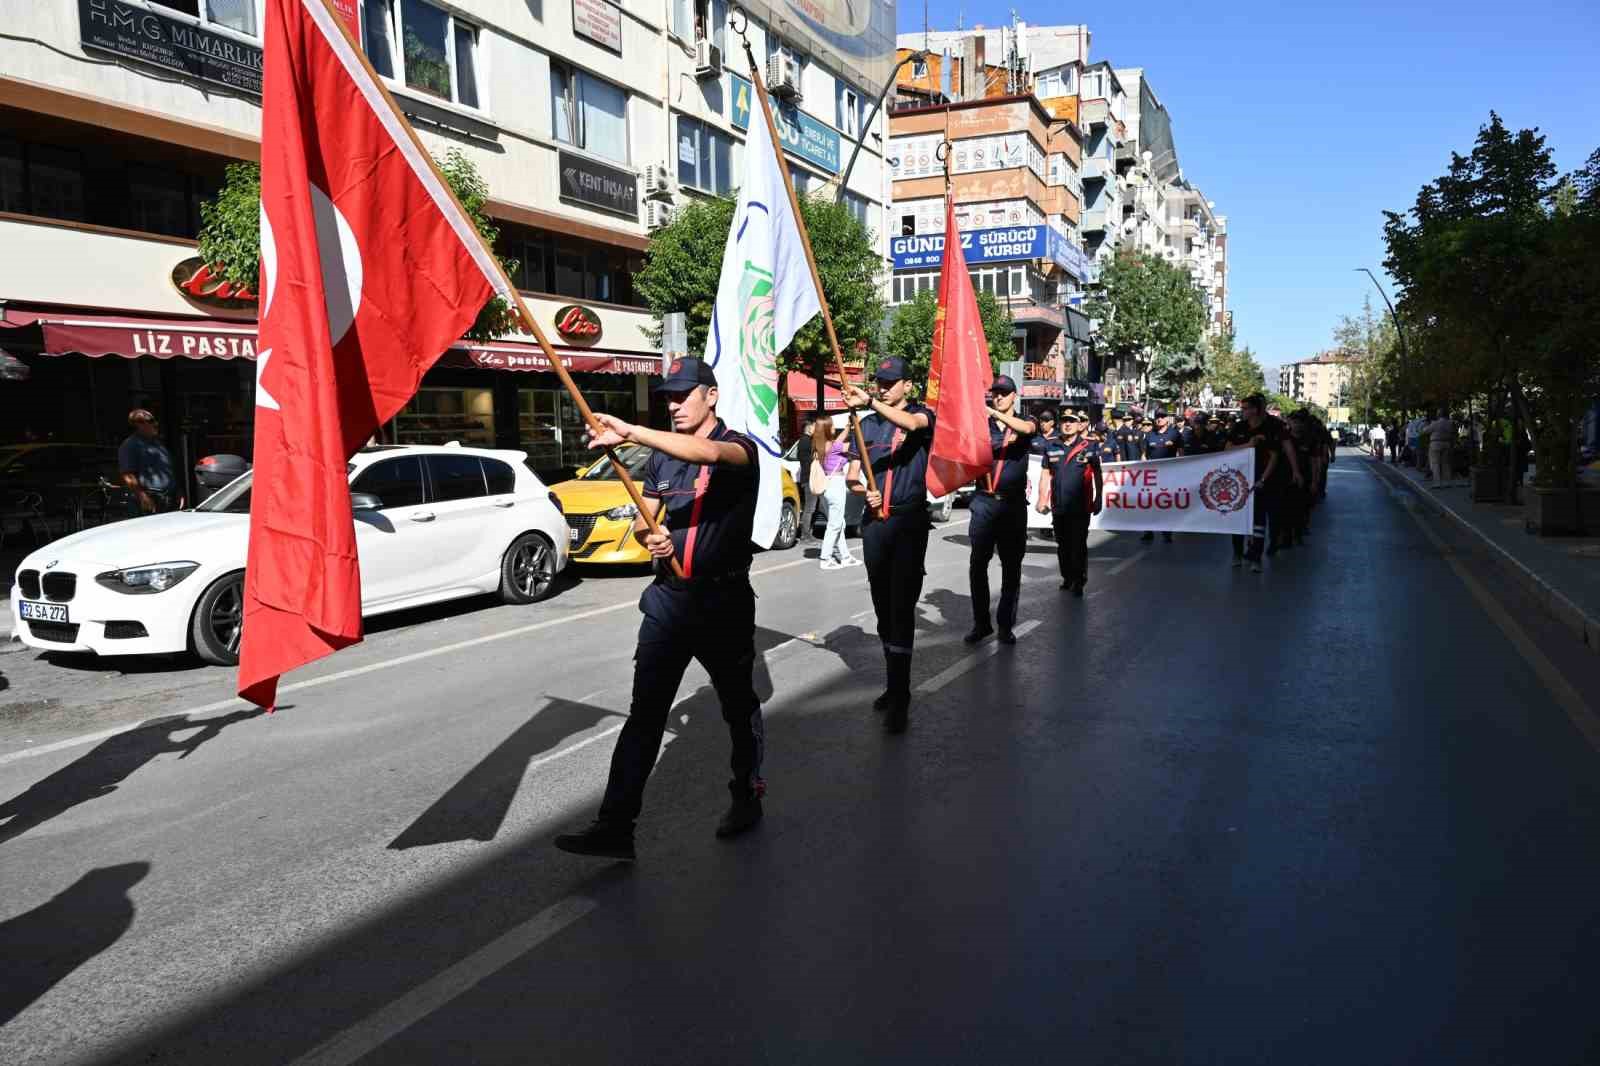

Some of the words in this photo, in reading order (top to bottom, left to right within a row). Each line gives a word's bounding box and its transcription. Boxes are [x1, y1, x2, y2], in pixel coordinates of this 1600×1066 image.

[894, 233, 973, 255] GÜNDZ
[979, 227, 1037, 245] SÜRÜCÜ
[983, 243, 1033, 258] KURSU
[132, 330, 172, 354] LİZ
[182, 335, 258, 357] PASTA
[508, 354, 573, 367] pastansi
[35, 604, 48, 619] SA
[49, 606, 66, 621] 272
